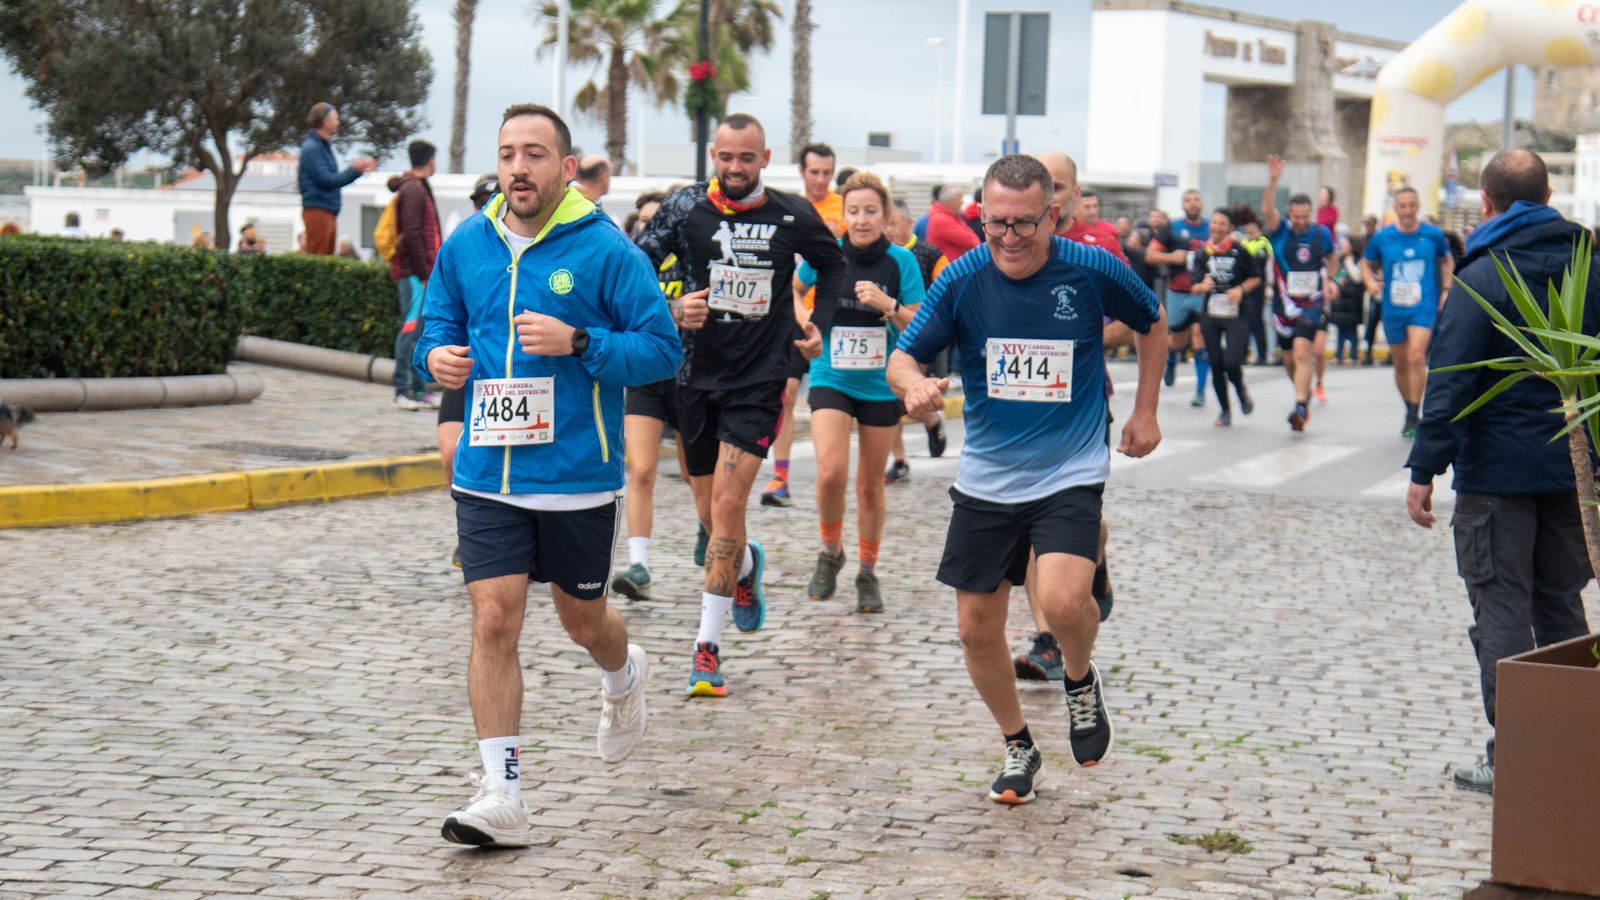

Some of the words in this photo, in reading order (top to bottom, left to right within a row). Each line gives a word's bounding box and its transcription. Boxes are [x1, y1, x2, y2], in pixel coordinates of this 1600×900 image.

[734, 222, 778, 240] XIV
[722, 269, 741, 280] XIV
[727, 280, 757, 299] 107
[1050, 284, 1077, 296] BRIGADA
[849, 338, 868, 355] 75
[1001, 343, 1027, 355] XIV
[1007, 355, 1050, 381] 414
[483, 384, 504, 397] XIV
[487, 396, 530, 422] 484
[577, 582, 602, 590] adidas
[505, 747, 518, 780] FILA
